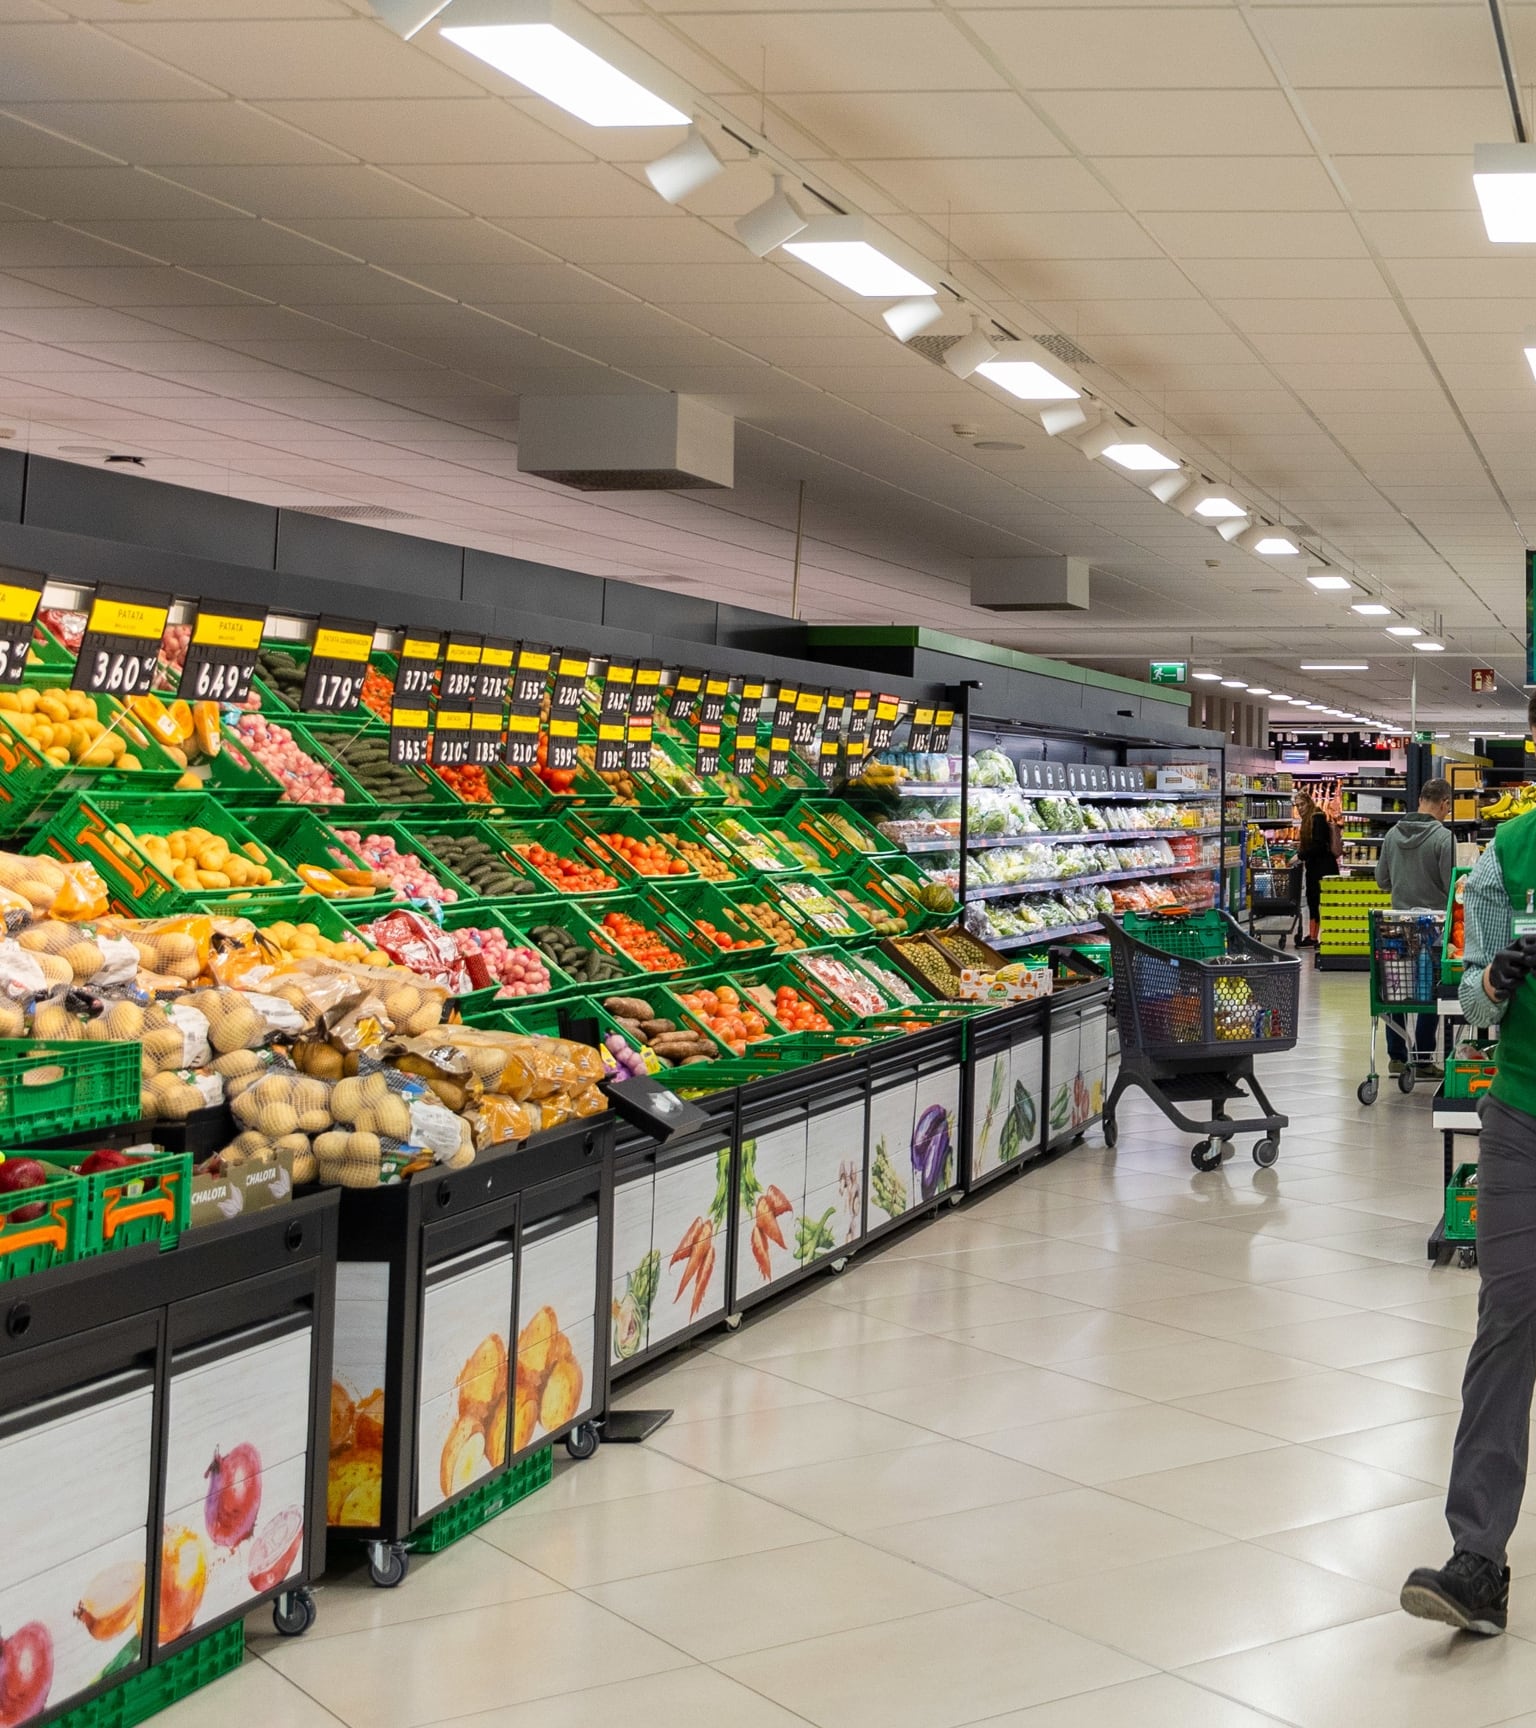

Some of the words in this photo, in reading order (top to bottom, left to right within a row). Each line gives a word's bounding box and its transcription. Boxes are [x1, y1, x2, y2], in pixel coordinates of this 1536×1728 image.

[118, 608, 144, 620] PATATA
[219, 621, 244, 633] PATATA
[246, 1168, 276, 1186] CHALOTA
[191, 1186, 227, 1204] CHALOTA
